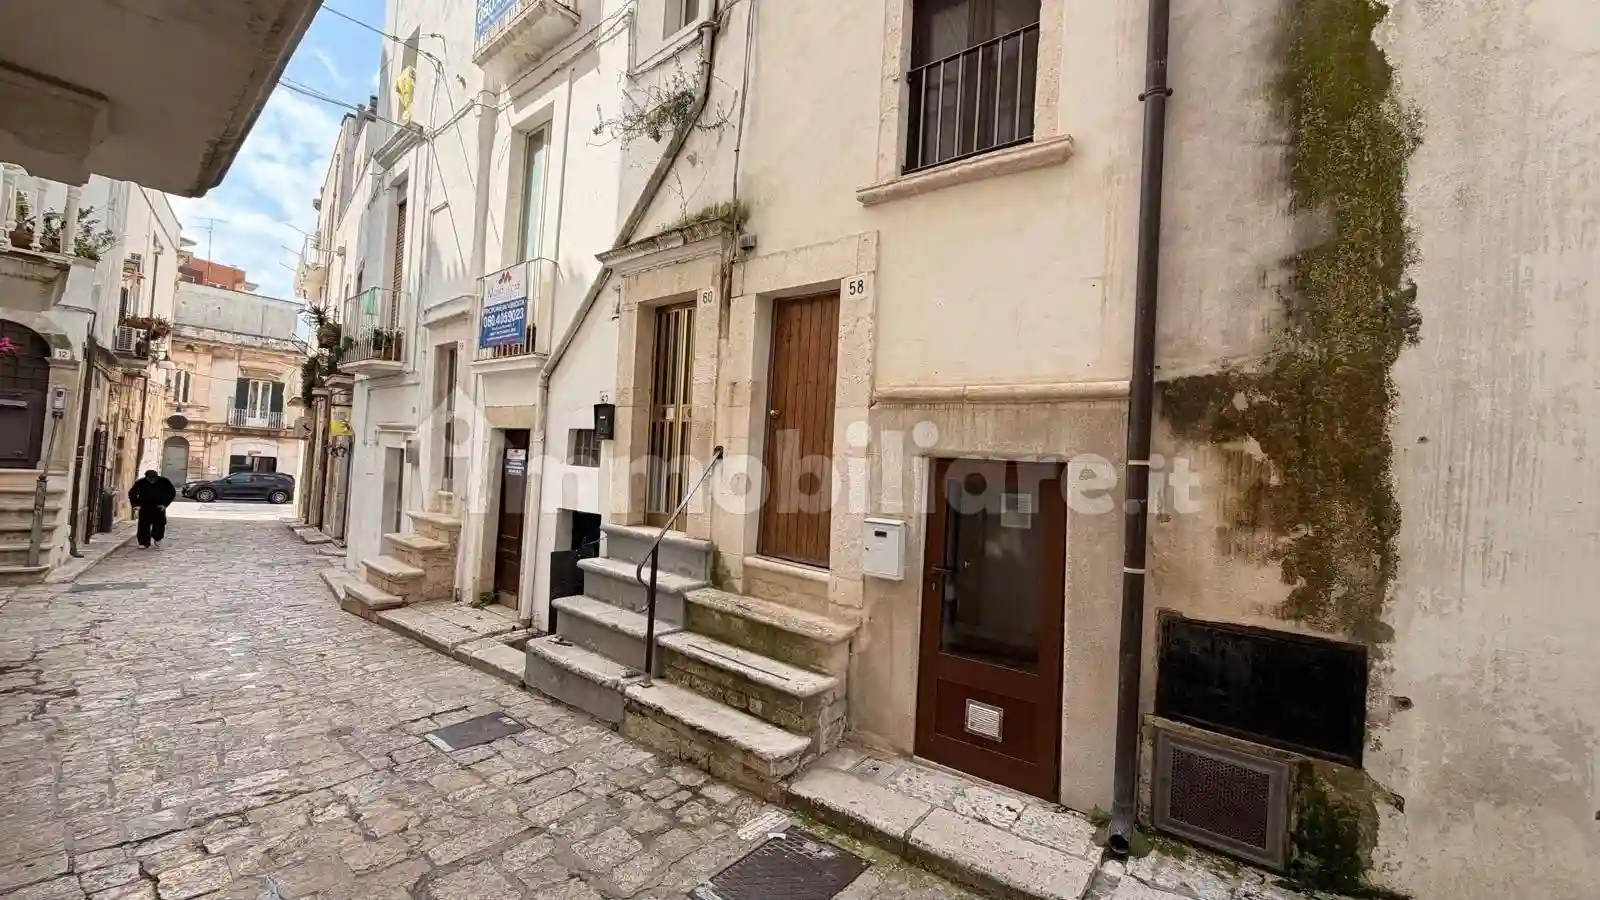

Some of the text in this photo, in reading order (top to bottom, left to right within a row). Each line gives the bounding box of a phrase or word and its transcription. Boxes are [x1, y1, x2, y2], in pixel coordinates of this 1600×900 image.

[849, 279, 864, 295] 58
[702, 290, 713, 304] 60
[60, 350, 69, 358] 12
